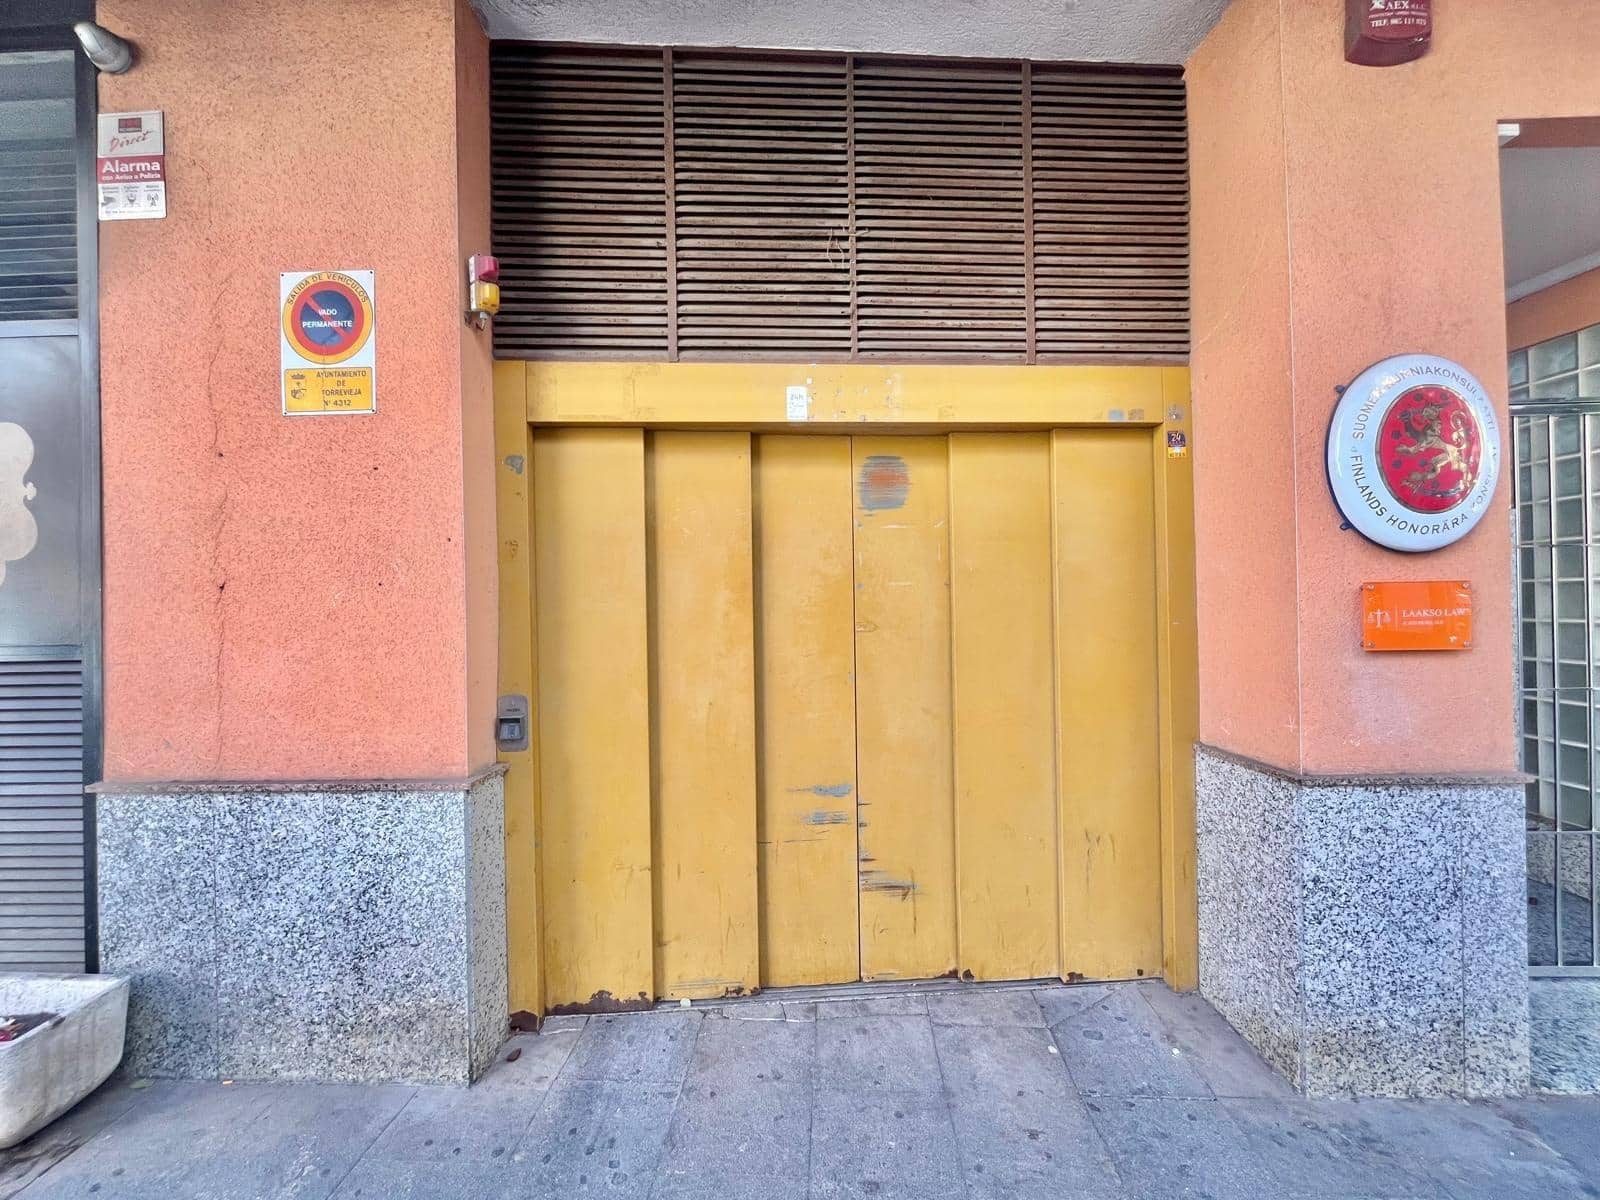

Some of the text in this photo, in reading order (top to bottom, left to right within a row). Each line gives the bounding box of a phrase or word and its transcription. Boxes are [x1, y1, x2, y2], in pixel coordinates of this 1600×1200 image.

[103, 159, 160, 173] Alarma
[287, 279, 311, 305] SALIDA
[311, 273, 323, 282] DE
[318, 308, 338, 316] VADO
[302, 319, 353, 329] PERMANENTE
[316, 370, 367, 378] AYUNTAMIENTO
[322, 388, 362, 397] TORREVIEJA
[333, 399, 352, 407] 4312
[1350, 455, 1388, 517] FINLANDS
[1386, 512, 1469, 535] HONORÄRA
[1402, 607, 1466, 618] LAAKSO LAW
